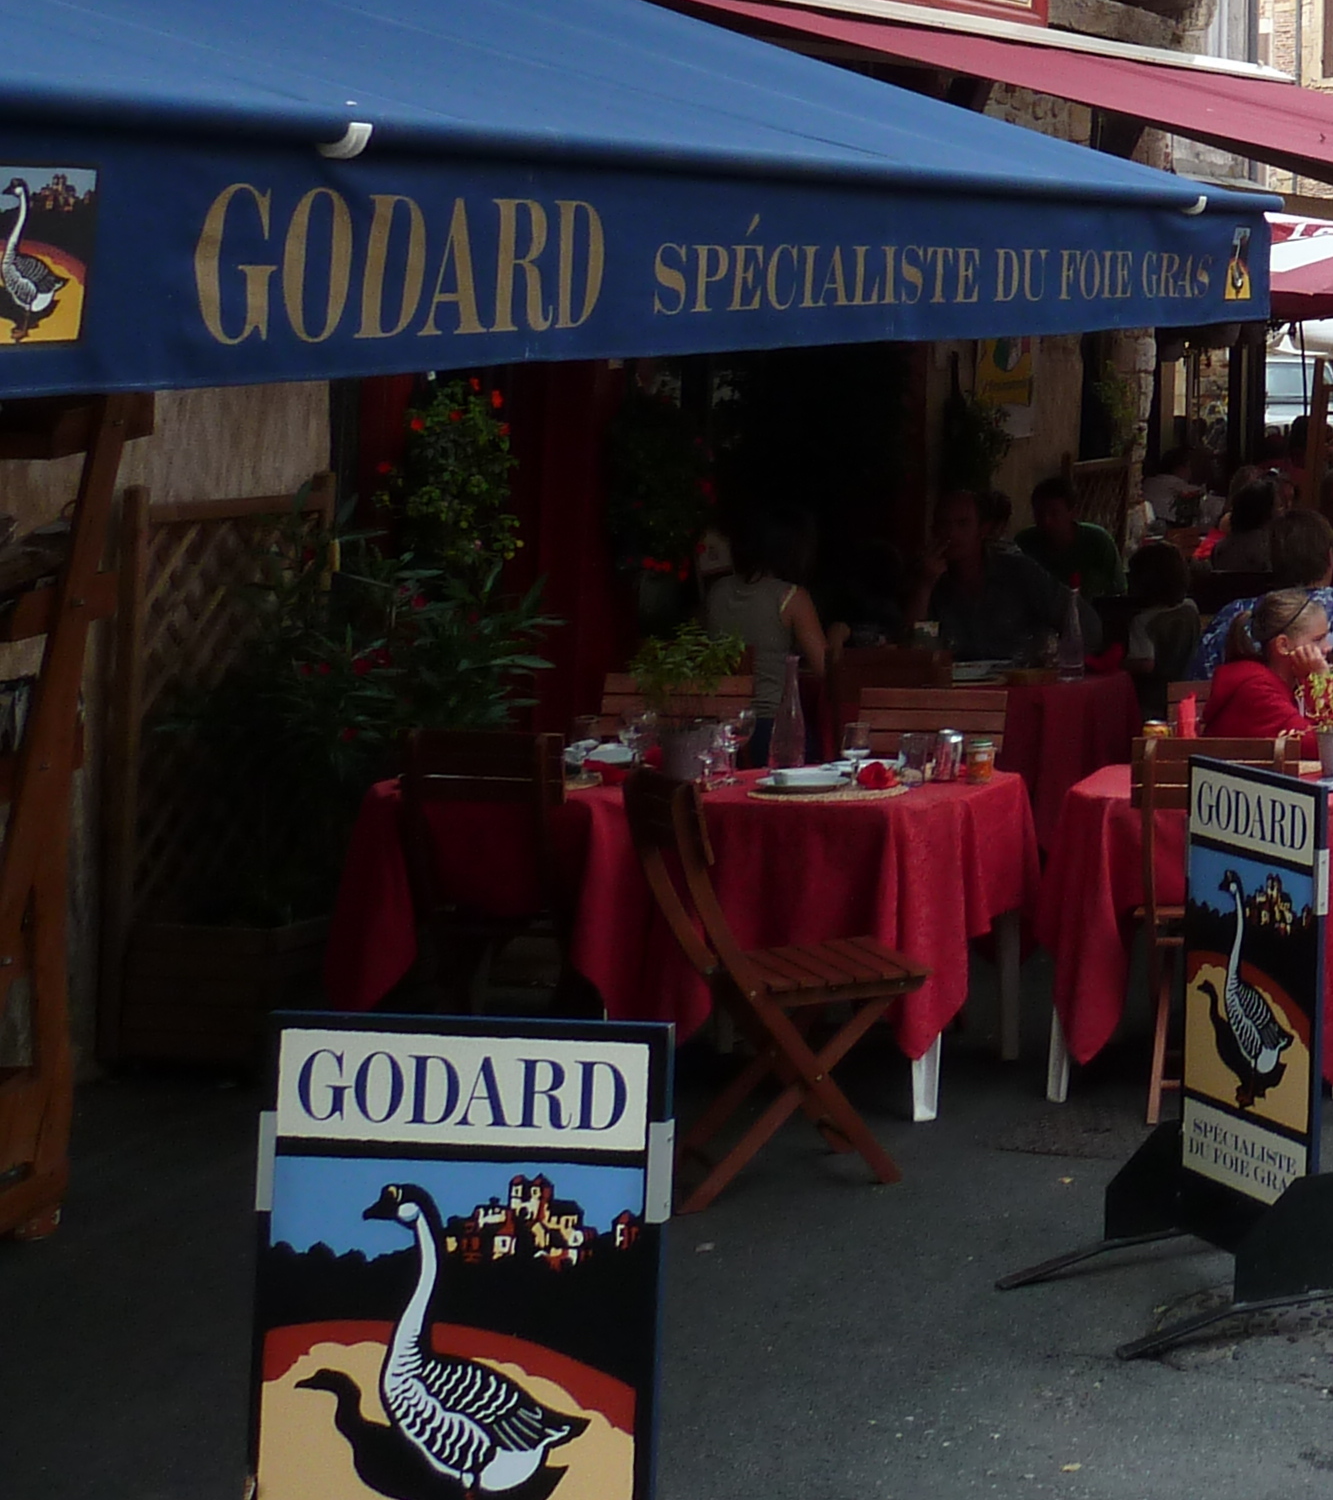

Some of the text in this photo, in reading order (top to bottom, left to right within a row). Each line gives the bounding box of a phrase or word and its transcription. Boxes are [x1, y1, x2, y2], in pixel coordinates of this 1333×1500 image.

[195, 183, 1213, 345] GODARD SPÉCIALISTE DU FOIE GRAS
[1197, 780, 1307, 851] GODARD
[297, 1048, 628, 1132] GODARD
[1189, 1136, 1288, 1193] DU FOIE GRA
[1193, 1118, 1297, 1176] SPÉCIALISTE
